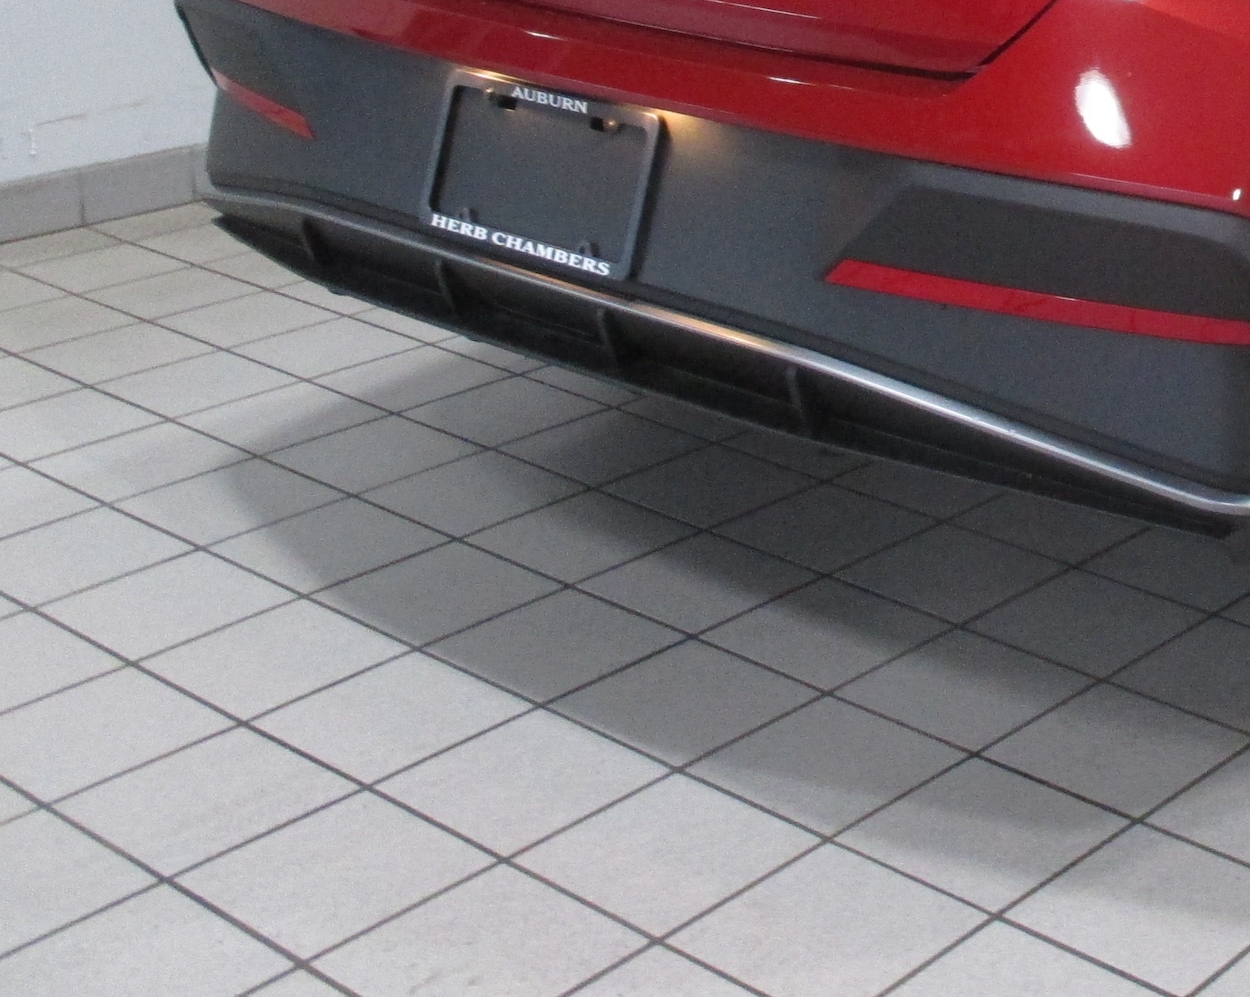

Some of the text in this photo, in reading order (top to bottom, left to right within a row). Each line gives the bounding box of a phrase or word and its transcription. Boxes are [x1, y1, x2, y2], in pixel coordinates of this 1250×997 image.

[511, 85, 589, 114] AUBURN
[431, 213, 610, 277] HERB CHAMBERS
